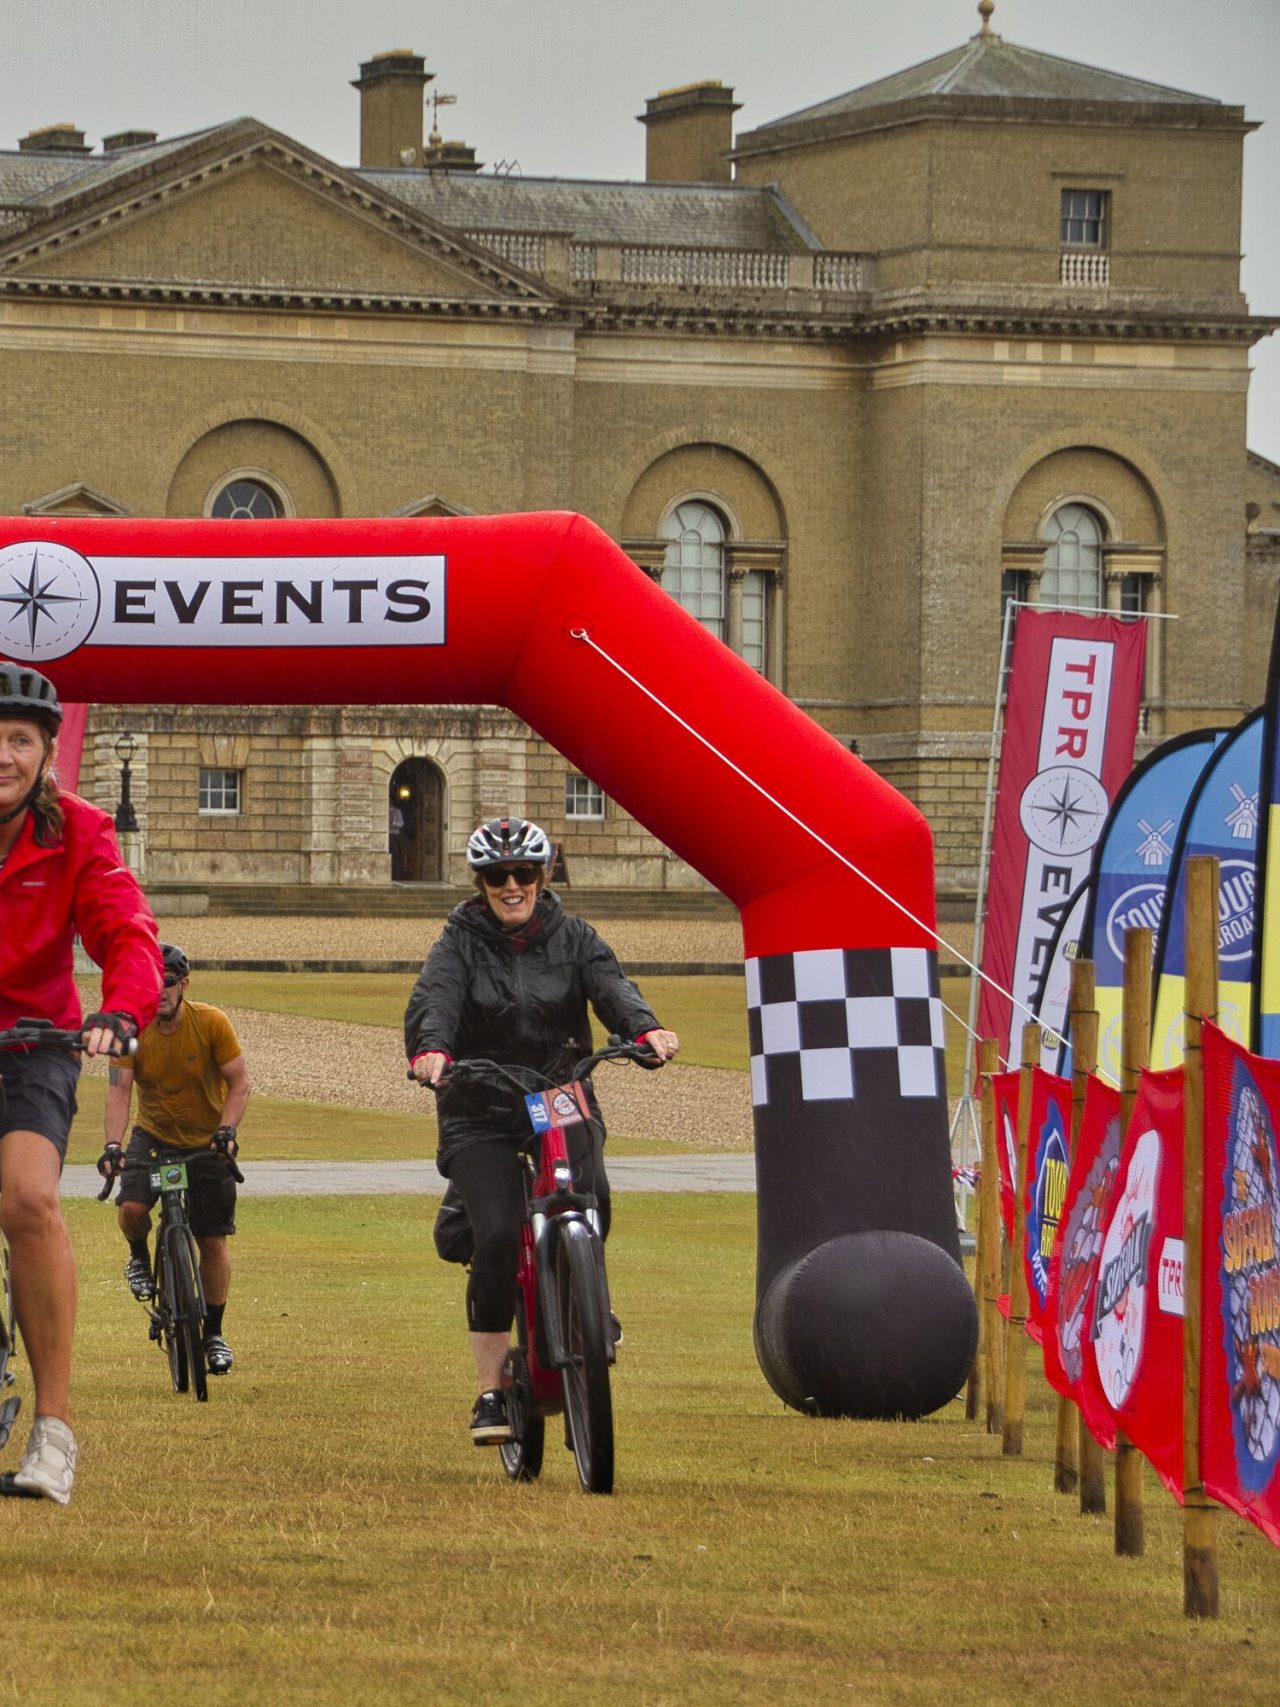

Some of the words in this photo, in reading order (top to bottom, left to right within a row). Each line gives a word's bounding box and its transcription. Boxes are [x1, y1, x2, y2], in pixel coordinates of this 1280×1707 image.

[113, 579, 432, 625] EVENTS
[1055, 654, 1097, 760] TPR
[531, 1103, 549, 1122] 317
